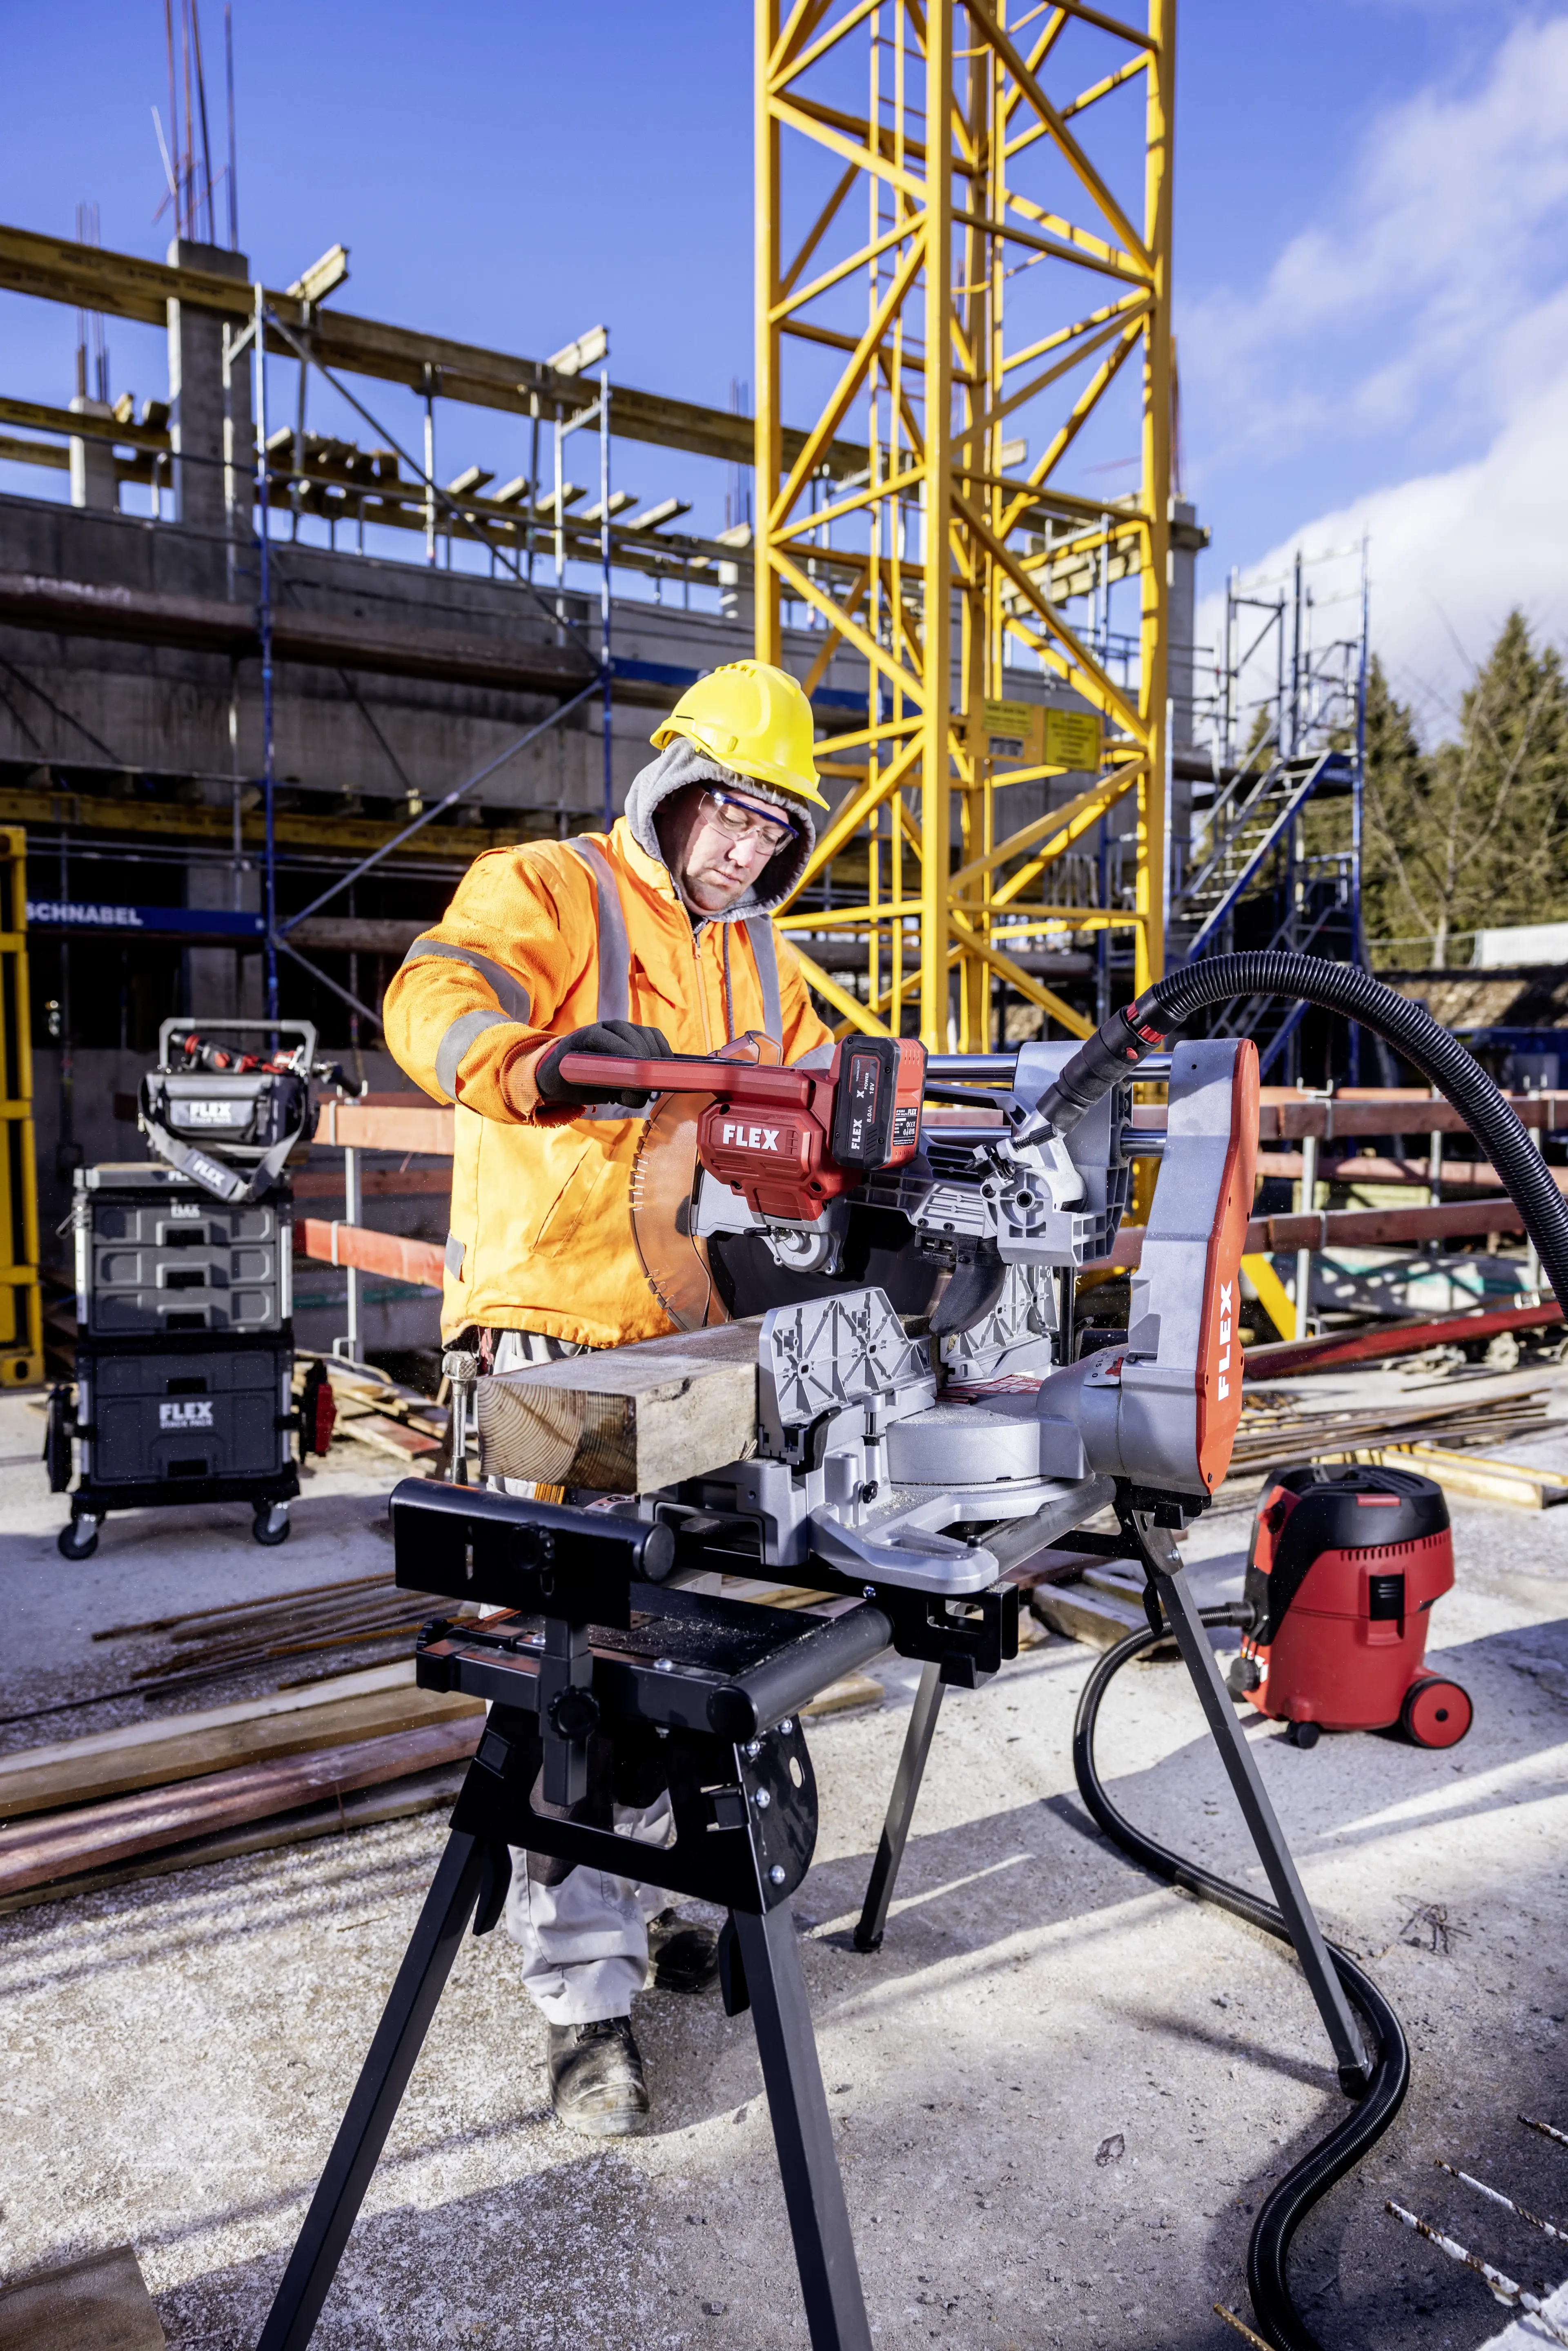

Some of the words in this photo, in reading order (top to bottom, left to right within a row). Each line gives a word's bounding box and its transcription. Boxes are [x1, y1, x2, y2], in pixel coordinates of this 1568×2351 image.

[25, 901, 143, 926] SCHNABEL
[856, 1090, 864, 1099] X
[189, 1102, 232, 1118] FLEX
[723, 1124, 780, 1151] FLEX
[851, 1119, 862, 1150] FLEX
[193, 1159, 225, 1187] FLEX
[1218, 1280, 1232, 1401] FLEX
[159, 1401, 213, 1420] FLEX
